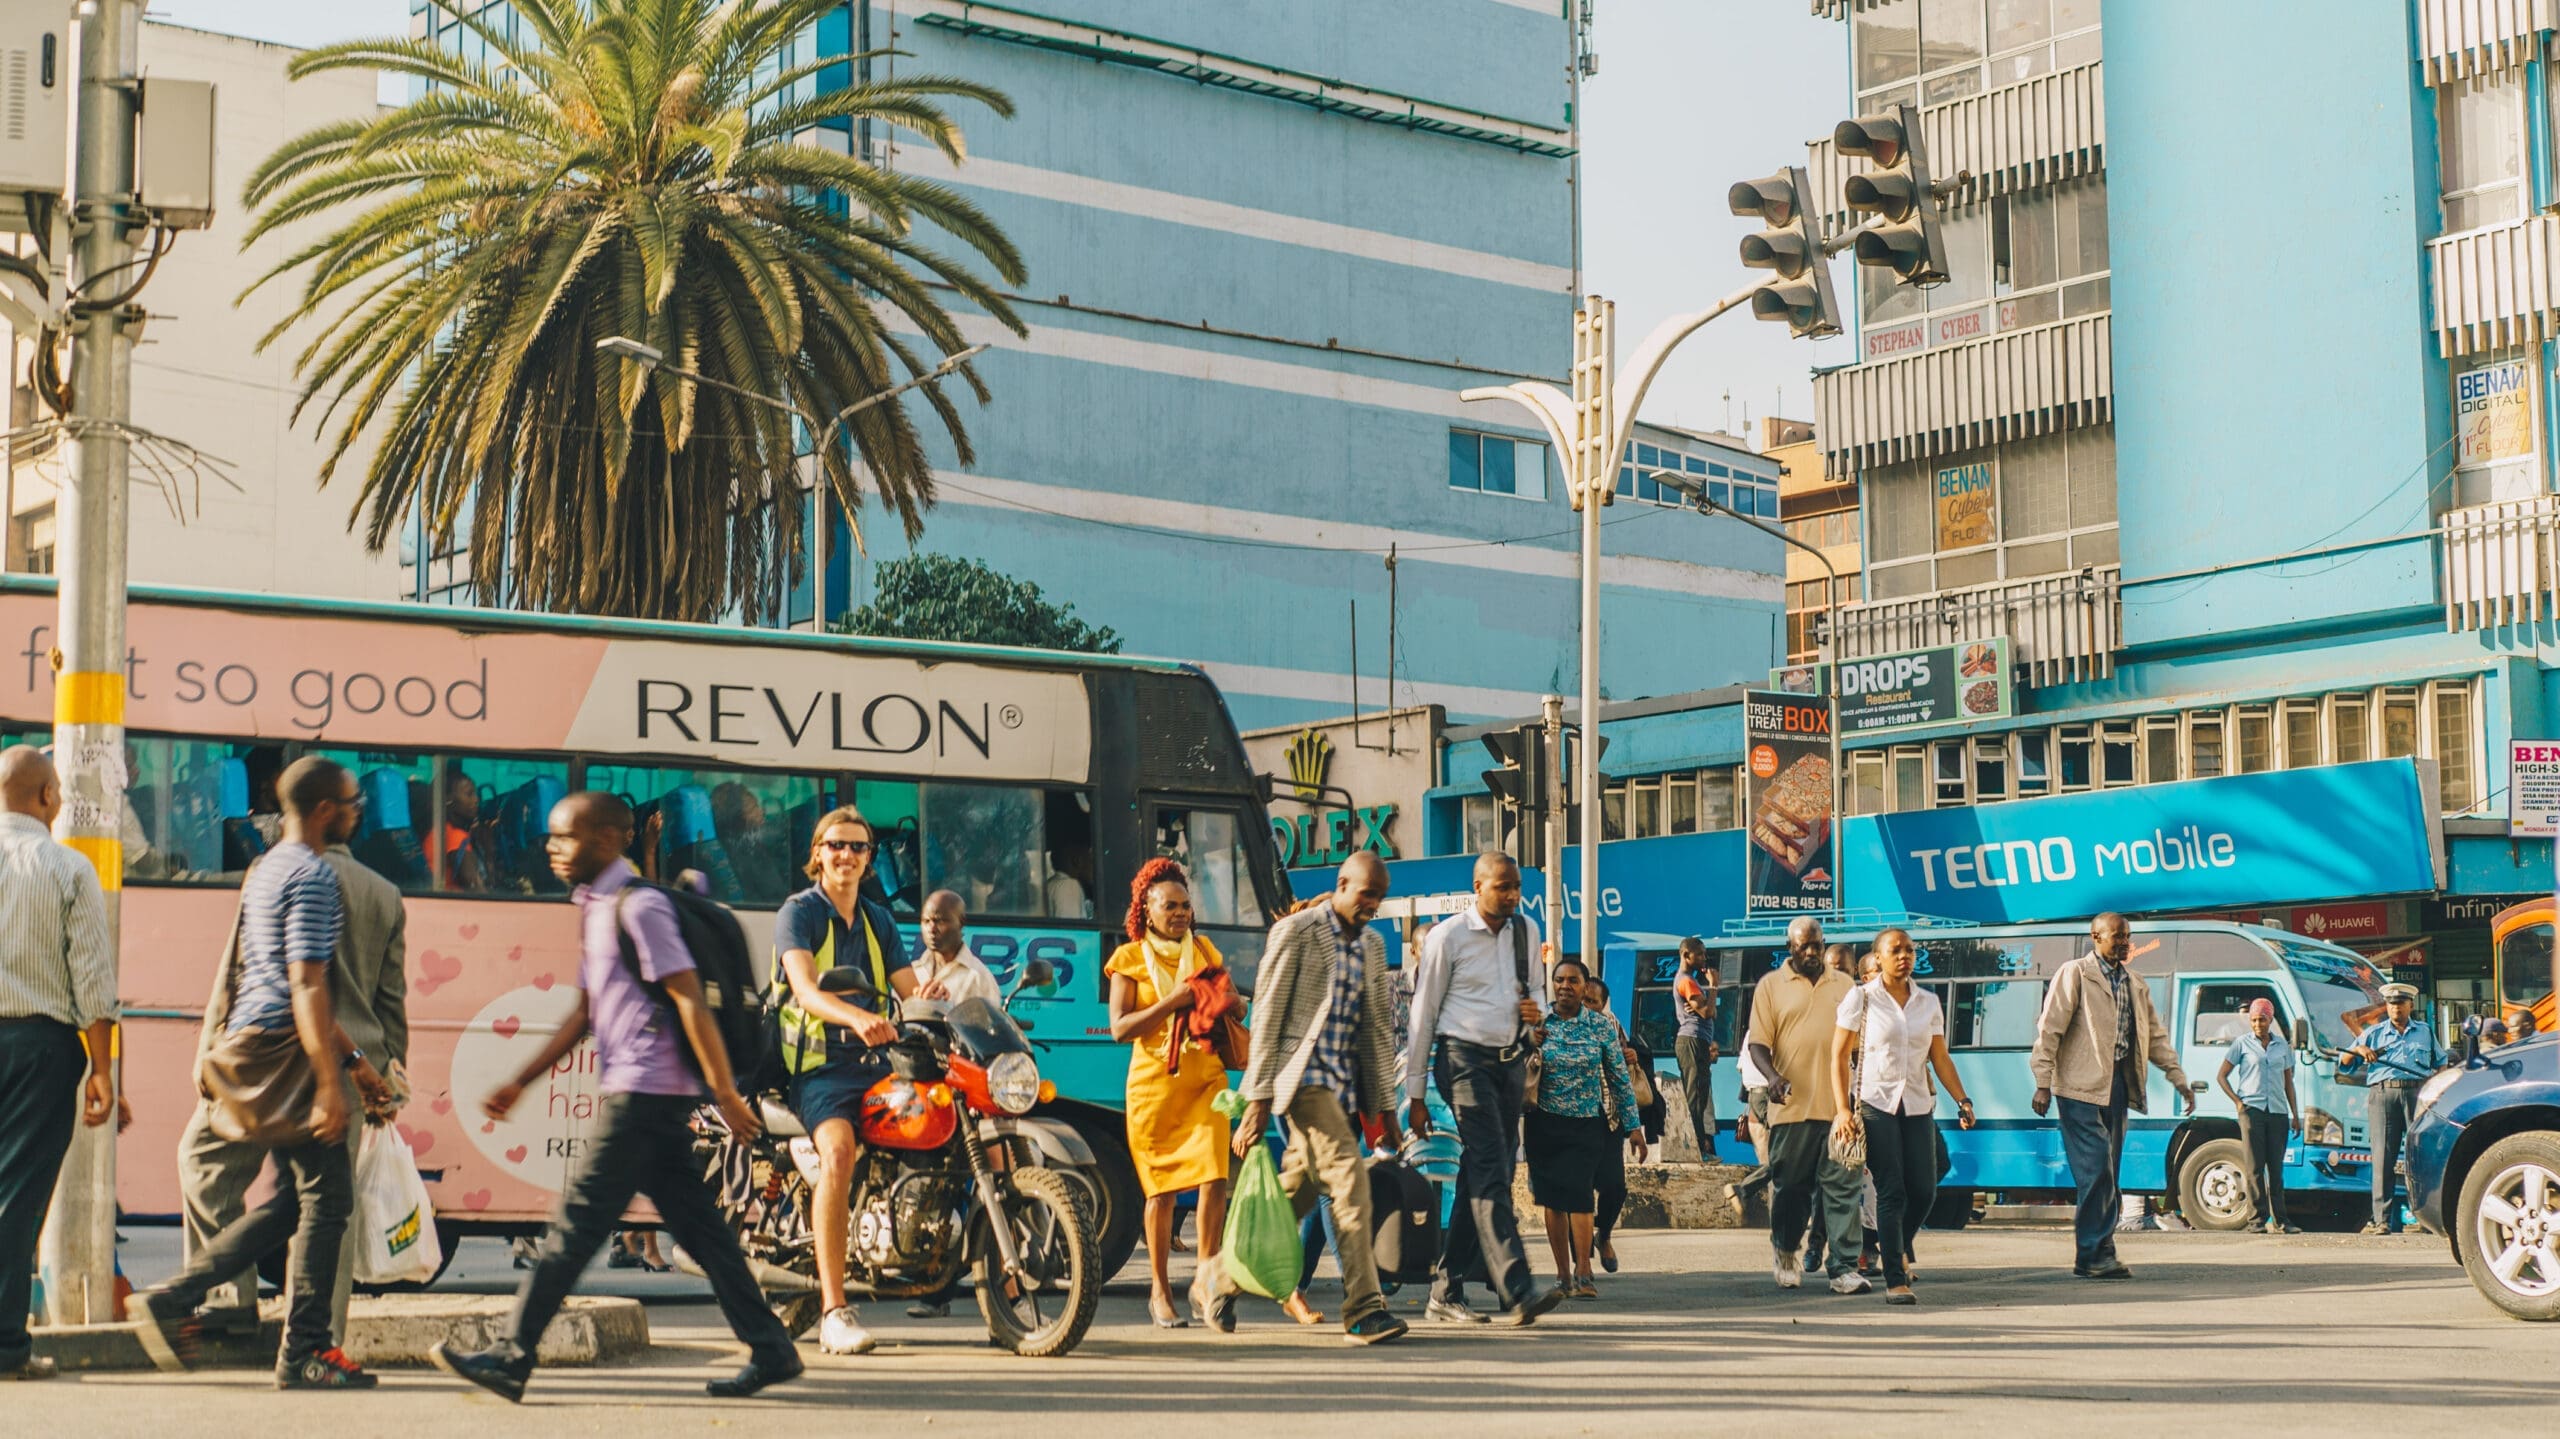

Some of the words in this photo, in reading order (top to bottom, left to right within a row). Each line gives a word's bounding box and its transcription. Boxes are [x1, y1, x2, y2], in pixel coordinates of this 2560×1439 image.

[1870, 326, 1923, 356] STEPHAN
[1941, 313, 1980, 340] CYBER
[2460, 366, 2524, 400] BENAN
[2461, 393, 2524, 413] DIGITAL
[1940, 463, 1992, 497] BENAN
[21, 625, 147, 699] ft
[175, 661, 259, 706] so
[290, 657, 488, 730] good
[1841, 655, 1931, 697] DROPS
[1865, 690, 1912, 706] Restaurant
[1749, 703, 1783, 717] TRIPLE
[1784, 706, 1830, 733] BOX
[1749, 716, 1783, 731] TREAT
[1911, 836, 2076, 891] TECNO
[1440, 897, 1454, 913] MOI
[1751, 895, 1780, 908] 0702
[1782, 896, 1798, 909] 45
[1800, 897, 1816, 909] 45
[1818, 898, 1833, 909] 45
[2330, 917, 2375, 929] HUAWEI
[2397, 972, 2423, 981] TECNO
